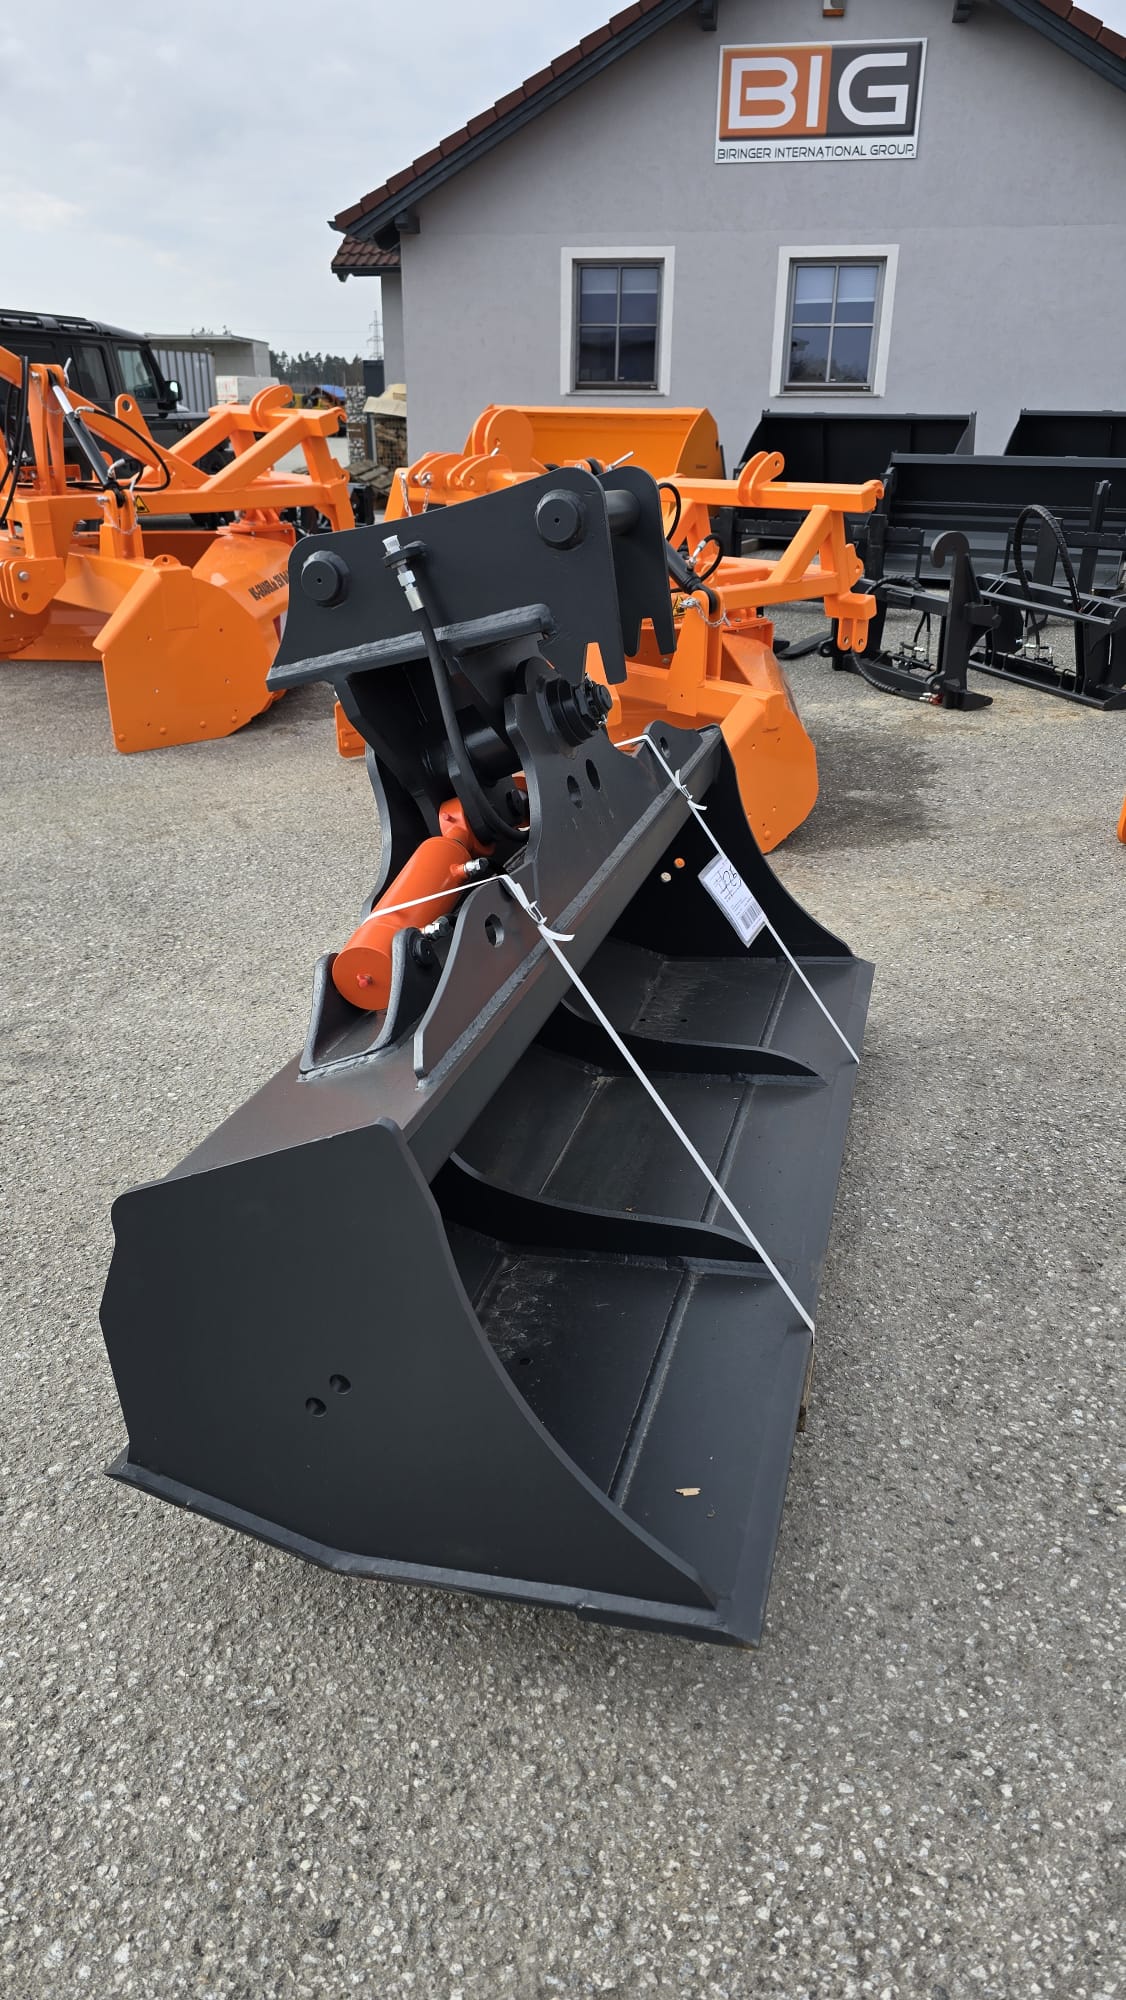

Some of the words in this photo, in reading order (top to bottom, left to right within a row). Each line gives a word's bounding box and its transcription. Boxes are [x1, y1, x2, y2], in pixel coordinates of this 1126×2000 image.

[728, 52, 909, 129] BIG
[717, 147, 772, 160] BIRINGER
[774, 145, 867, 159] INTERNATIONAL
